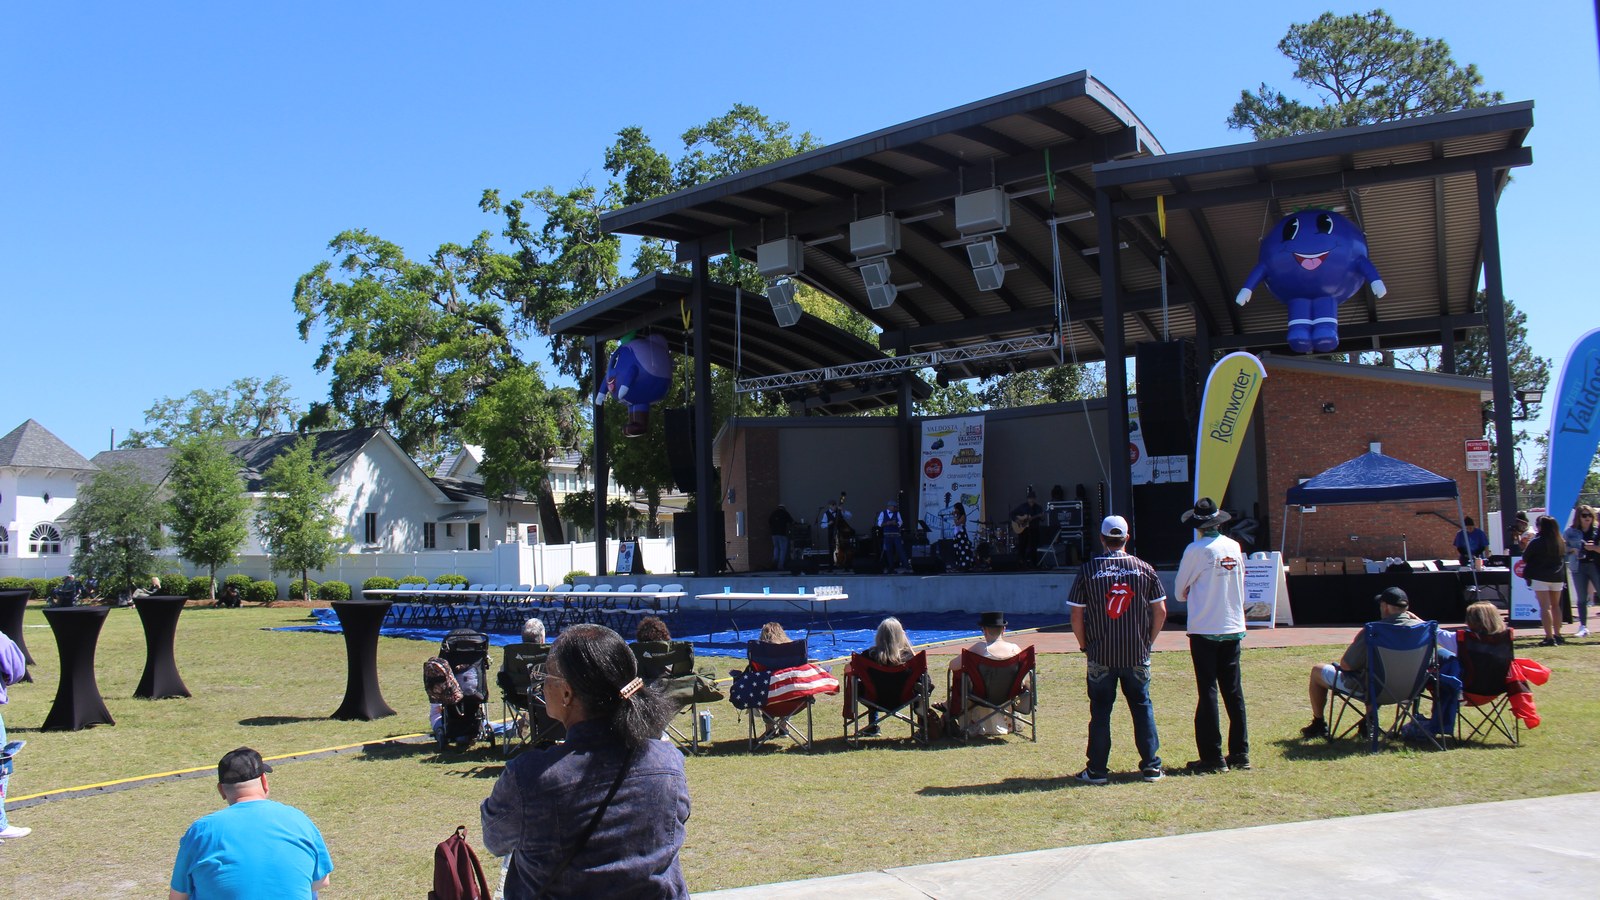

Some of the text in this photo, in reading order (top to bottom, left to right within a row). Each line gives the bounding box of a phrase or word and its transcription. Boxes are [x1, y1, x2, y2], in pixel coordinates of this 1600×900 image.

[1210, 368, 1251, 443] Rainwater
[927, 424, 958, 432] VALDOSTA
[1092, 569, 1120, 581] Rolling
